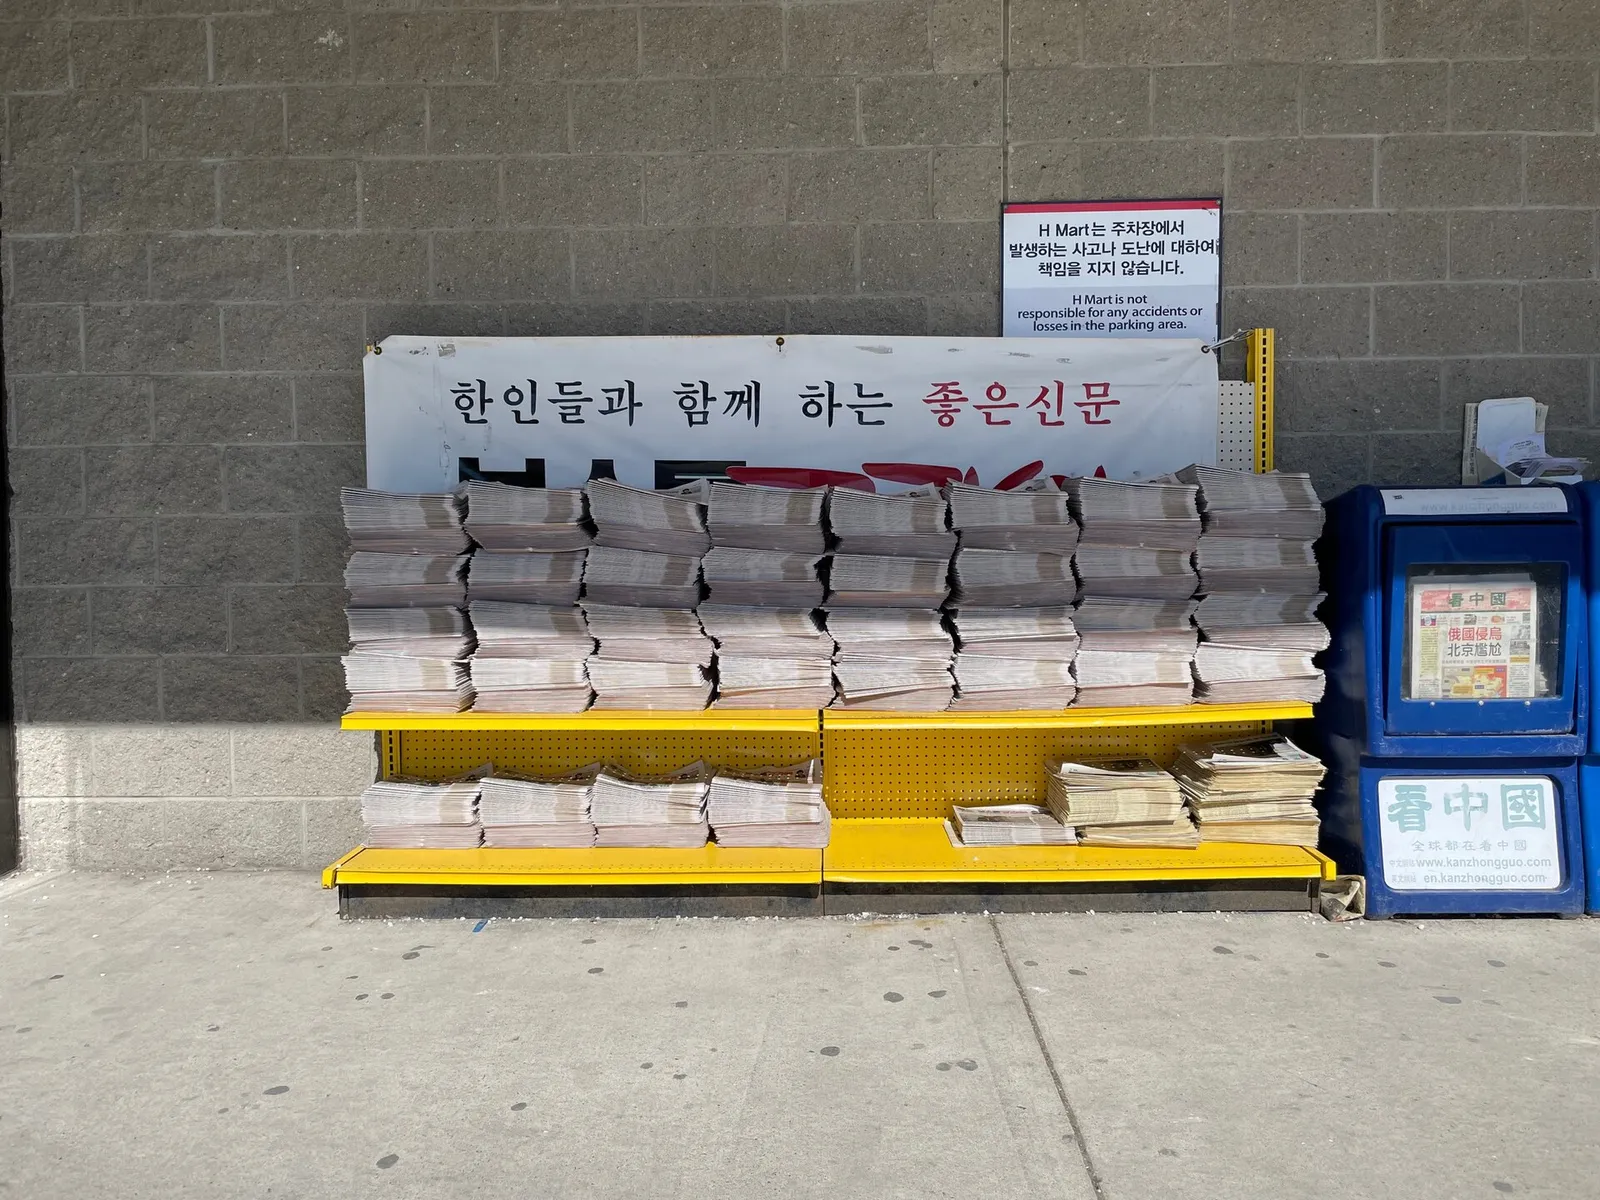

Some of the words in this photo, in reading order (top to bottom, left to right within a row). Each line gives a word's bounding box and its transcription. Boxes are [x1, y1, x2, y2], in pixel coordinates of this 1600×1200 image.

[1039, 224, 1050, 237] H
[1055, 222, 1106, 237] Mart는
[1111, 220, 1184, 236] 주차장에서
[1009, 242, 1067, 258] 발생하는
[1072, 241, 1116, 257] 사고나
[1121, 241, 1165, 255] 도난에
[1171, 239, 1215, 254] 대하여
[1038, 261, 1081, 277] 책임을
[1087, 261, 1116, 276] 지지
[1121, 259, 1184, 276] 않습니다.
[1072, 295, 1082, 305] H
[1084, 294, 1113, 305] Mart
[1115, 294, 1124, 304] is
[1127, 294, 1147, 304] not
[1018, 308, 1085, 320] responsible
[1088, 307, 1105, 318] for
[1107, 309, 1129, 320] any
[1132, 306, 1187, 317] accidents
[1190, 307, 1203, 316] or
[1033, 321, 1068, 331] losses
[1070, 321, 1082, 331] in
[1085, 320, 1105, 330] the
[1108, 319, 1155, 332] parking
[1158, 320, 1187, 329] area.
[449, 377, 643, 427] 한인들과
[672, 379, 762, 428] 함께
[798, 379, 894, 428] 하는
[921, 379, 1121, 428] 좋은신문
[1387, 783, 1546, 833] 看中國
[1411, 839, 1527, 852] 全球都在看中國
[1416, 857, 1552, 869] www.kanzhongguo.com
[1424, 872, 1546, 885] en.kanzhongguo.com
